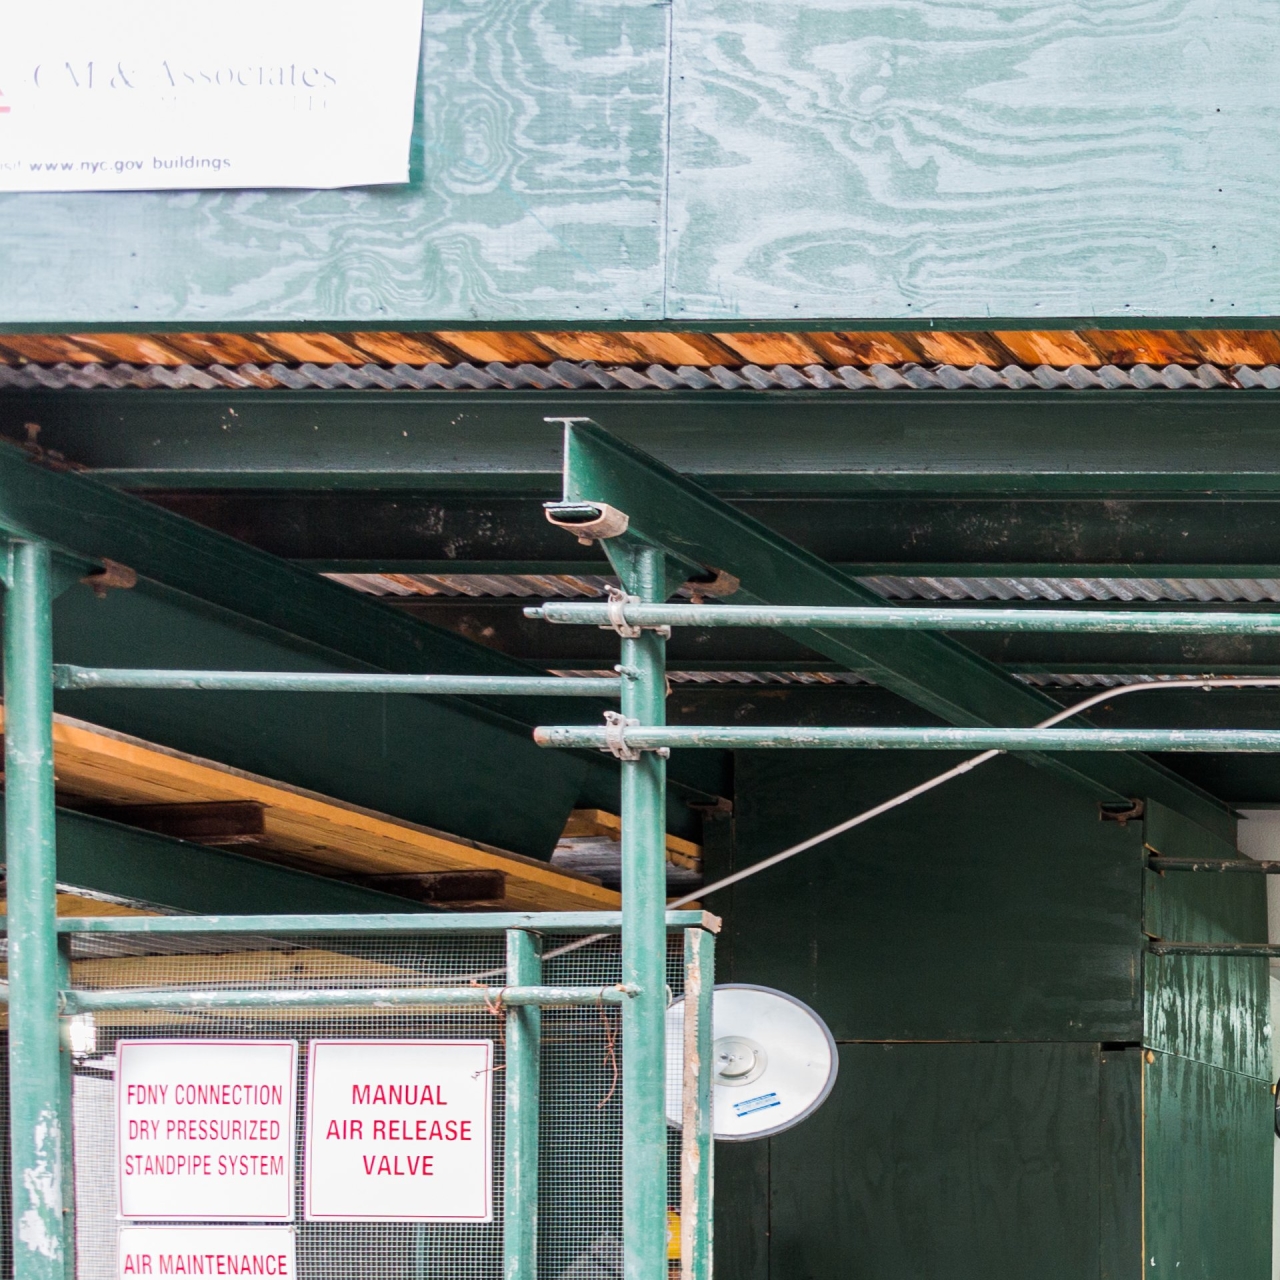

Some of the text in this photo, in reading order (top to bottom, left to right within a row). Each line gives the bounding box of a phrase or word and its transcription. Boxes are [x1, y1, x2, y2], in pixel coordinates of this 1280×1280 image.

[127, 1084, 284, 1106] FDNY CONNECTION
[352, 1084, 448, 1106] MANUAL
[128, 1119, 281, 1141] DRY PRESSURIZED
[326, 1120, 472, 1141] AIR RELEASE
[125, 1154, 285, 1176] STANDPIPE SYSTEM
[363, 1155, 434, 1176] VALVE
[124, 1254, 288, 1276] AIR MAINTENANCE
